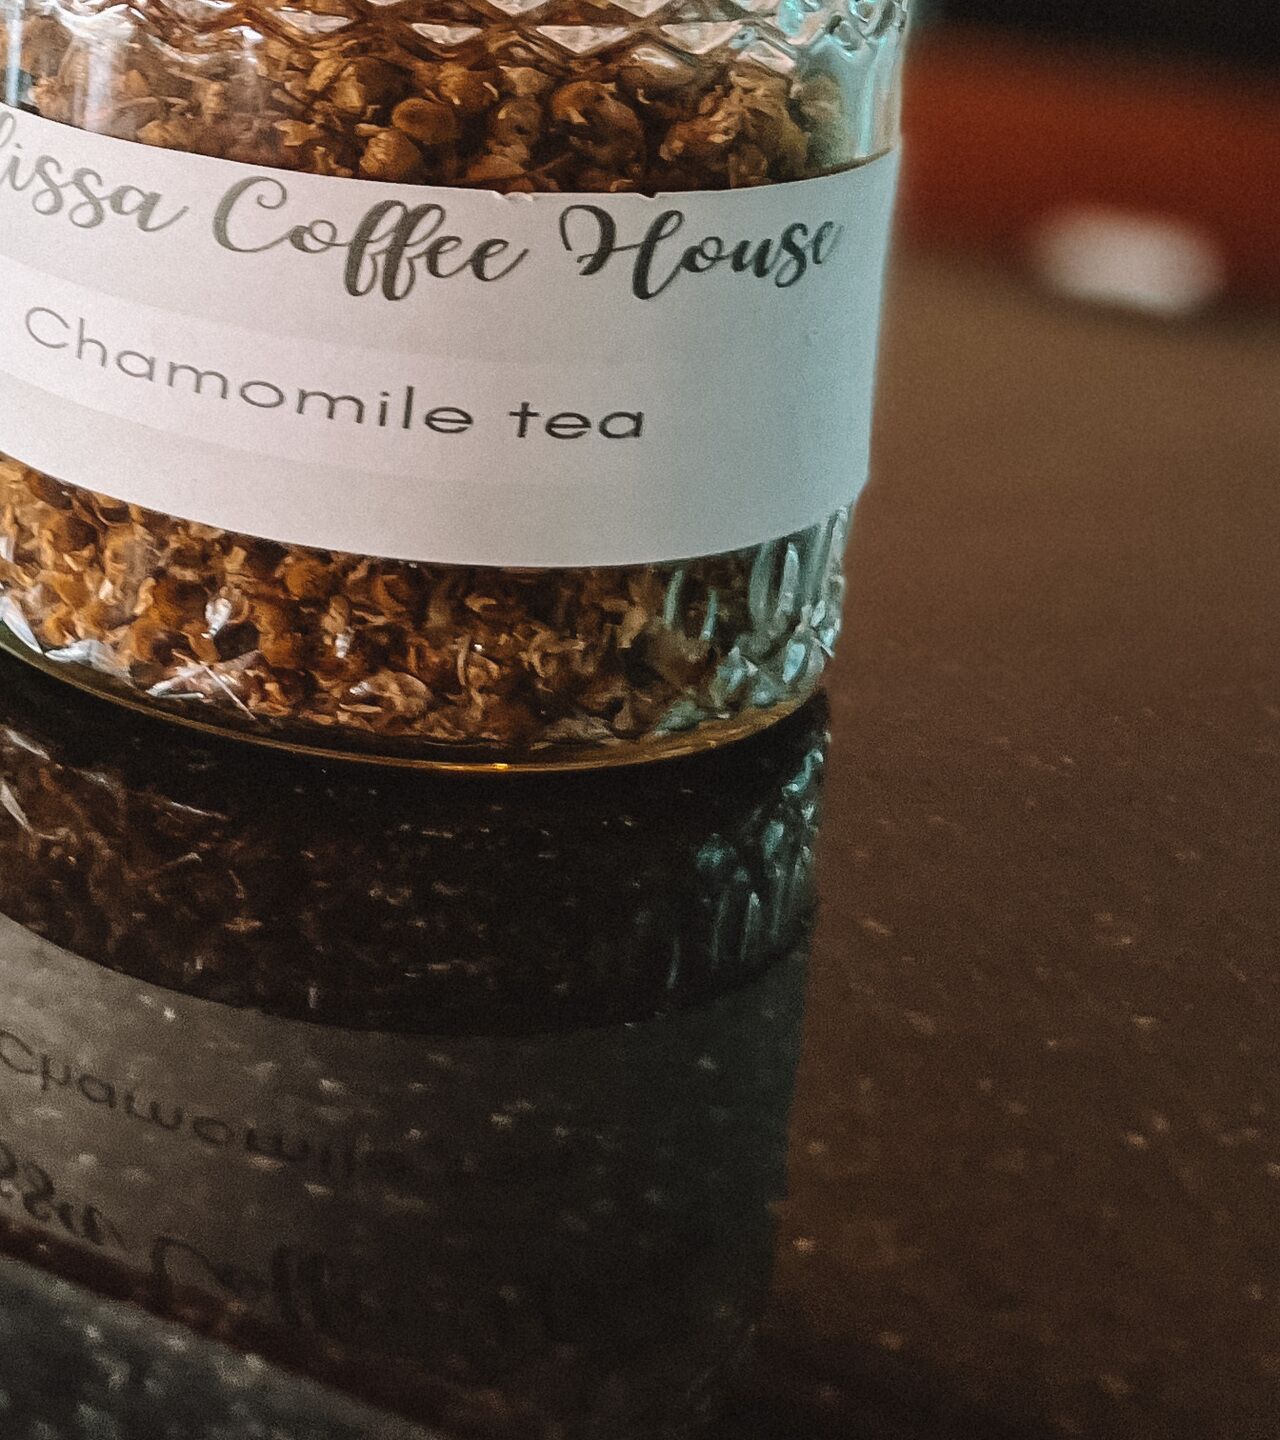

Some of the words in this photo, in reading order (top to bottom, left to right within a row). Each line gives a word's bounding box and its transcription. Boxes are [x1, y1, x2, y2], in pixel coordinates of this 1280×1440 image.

[212, 174, 530, 302] Coffee
[558, 204, 844, 300] House
[24, 305, 473, 436] Chamomile
[509, 400, 645, 441] tea
